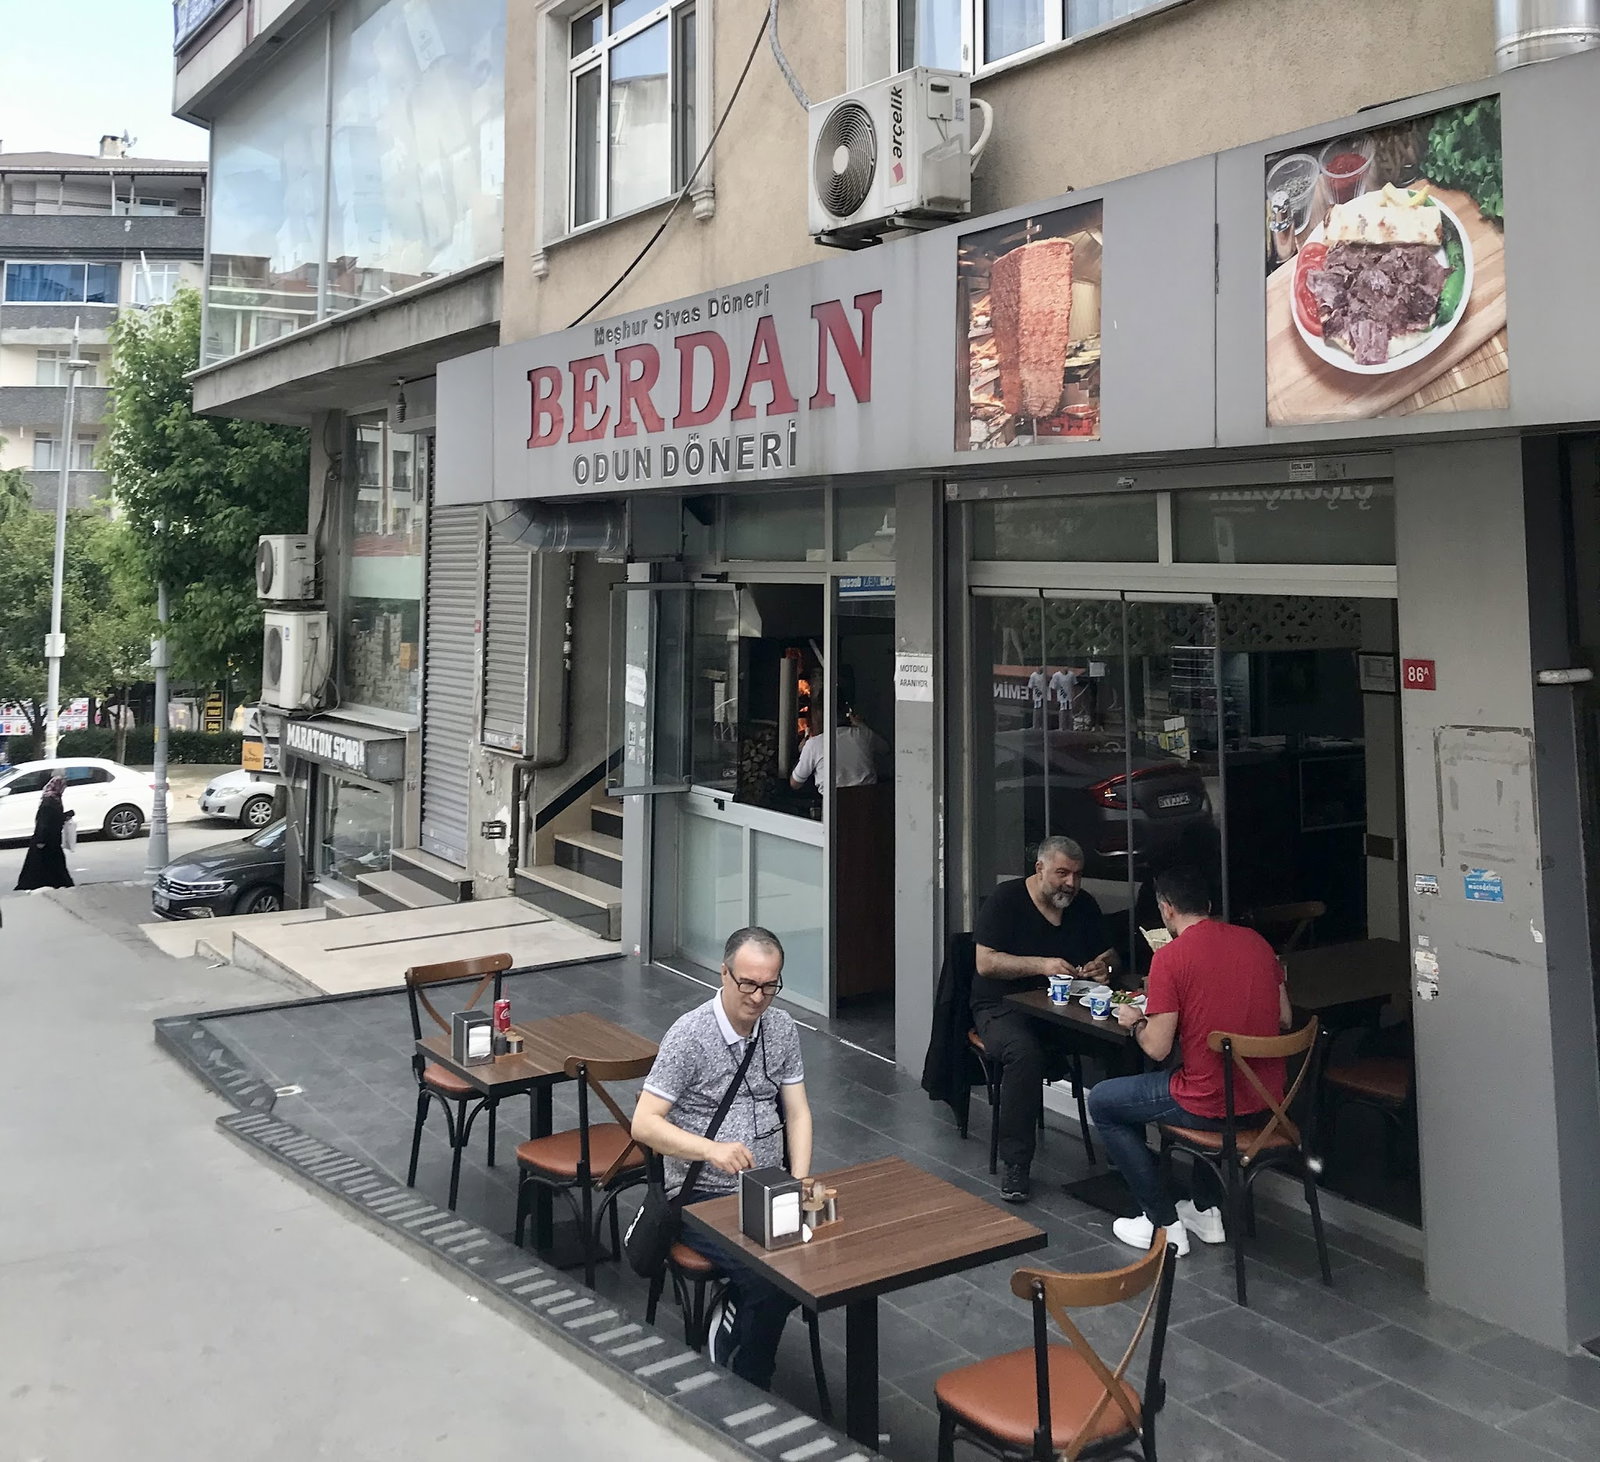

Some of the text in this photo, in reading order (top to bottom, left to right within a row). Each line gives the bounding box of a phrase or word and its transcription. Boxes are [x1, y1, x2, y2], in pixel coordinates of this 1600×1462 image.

[890, 86, 905, 159] arçelik
[653, 306, 701, 331] Sivas
[708, 283, 770, 320] Döneri
[526, 289, 883, 449] BERDAN
[574, 418, 798, 486] ODUN DÖNERİ
[899, 664, 928, 673] MOTORCU
